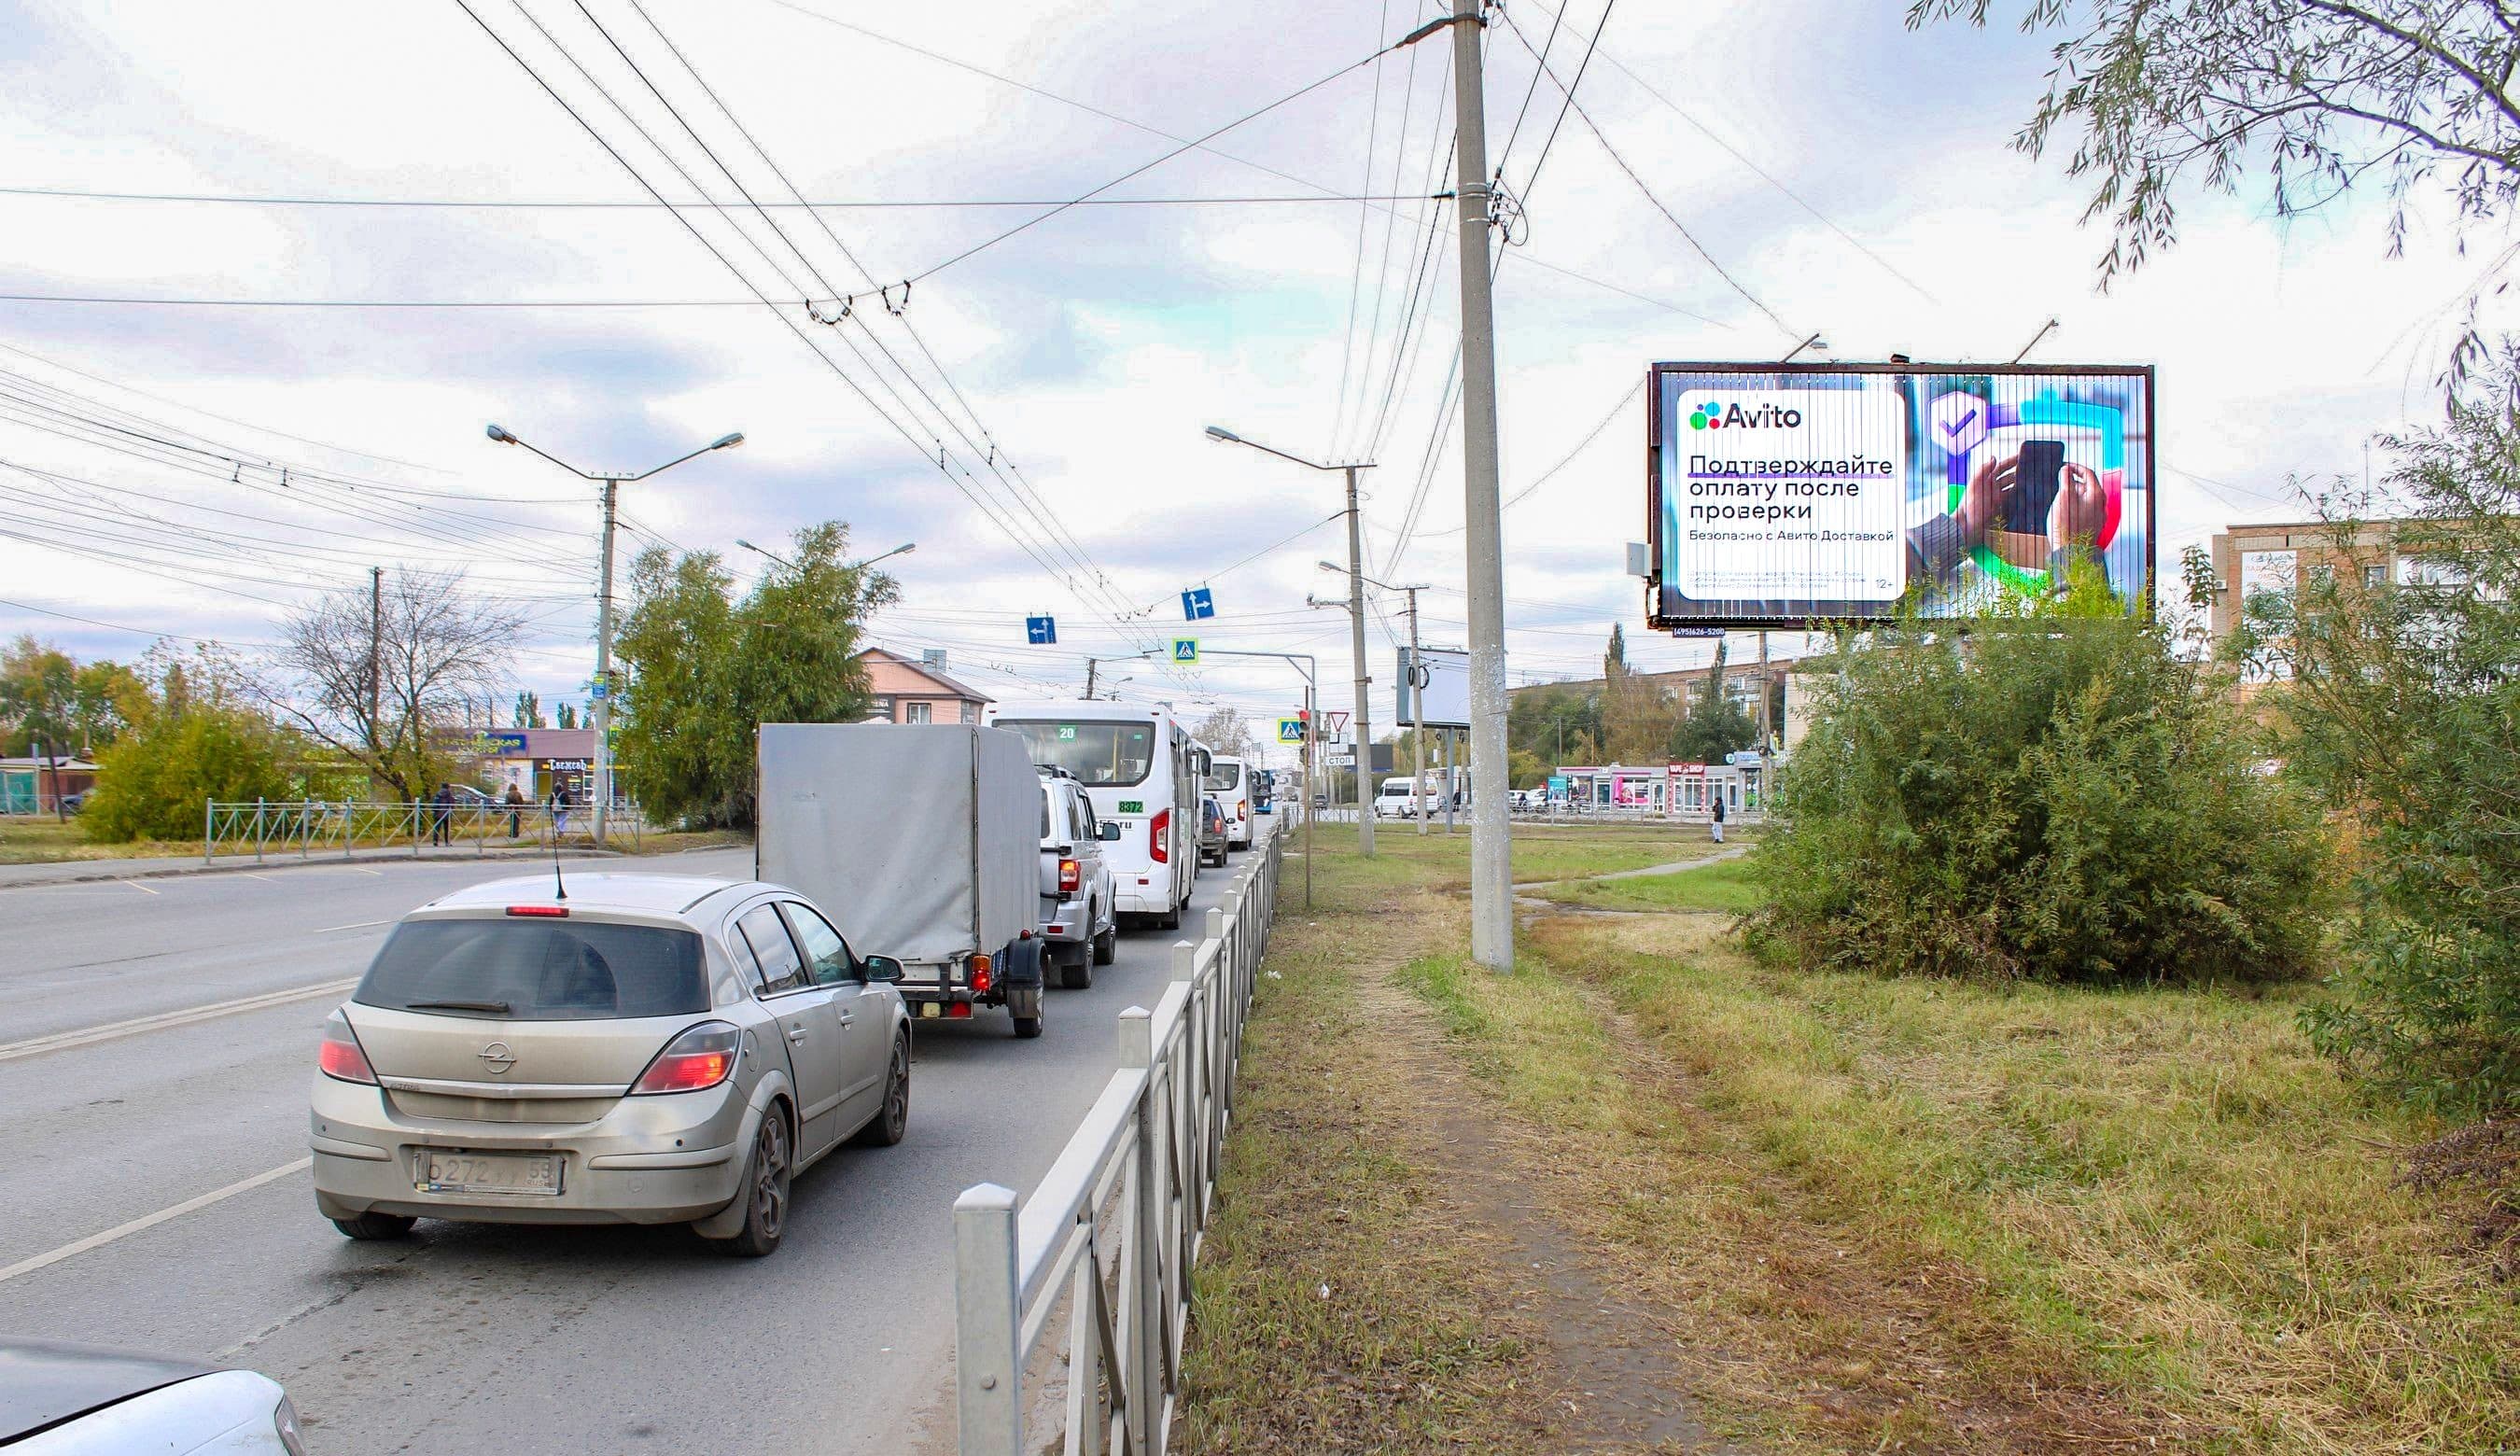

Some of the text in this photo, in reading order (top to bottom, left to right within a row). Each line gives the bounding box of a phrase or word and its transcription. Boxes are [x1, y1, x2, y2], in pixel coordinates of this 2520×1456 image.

[1722, 402, 1802, 428] Avito
[1690, 455, 1893, 475] Подтверждайте
[1689, 482, 1859, 501] оплату после
[1690, 505, 1812, 524] проверки
[1689, 530, 1763, 540] Безопасно
[1777, 531, 1818, 540] Авито
[1821, 530, 1894, 542] Доставкой
[1059, 728, 1074, 738] 20
[1119, 802, 1143, 813] 8372
